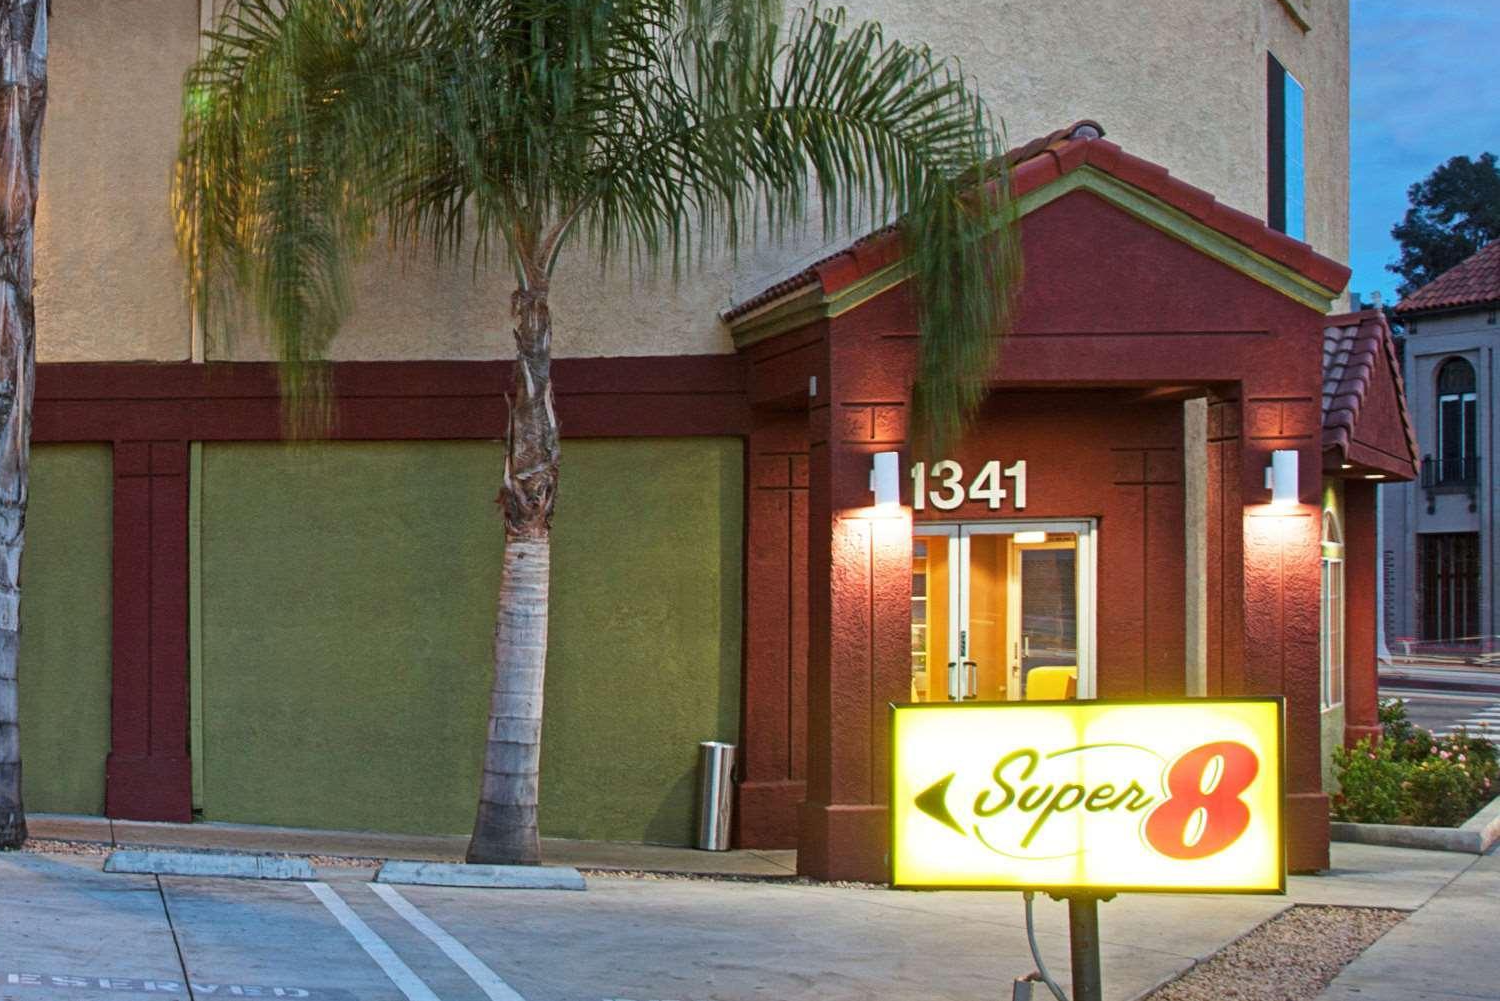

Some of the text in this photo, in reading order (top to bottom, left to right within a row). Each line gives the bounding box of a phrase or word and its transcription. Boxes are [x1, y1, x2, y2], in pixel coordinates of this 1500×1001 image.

[910, 459, 1027, 510] 1341
[972, 740, 1260, 860] Super 8
